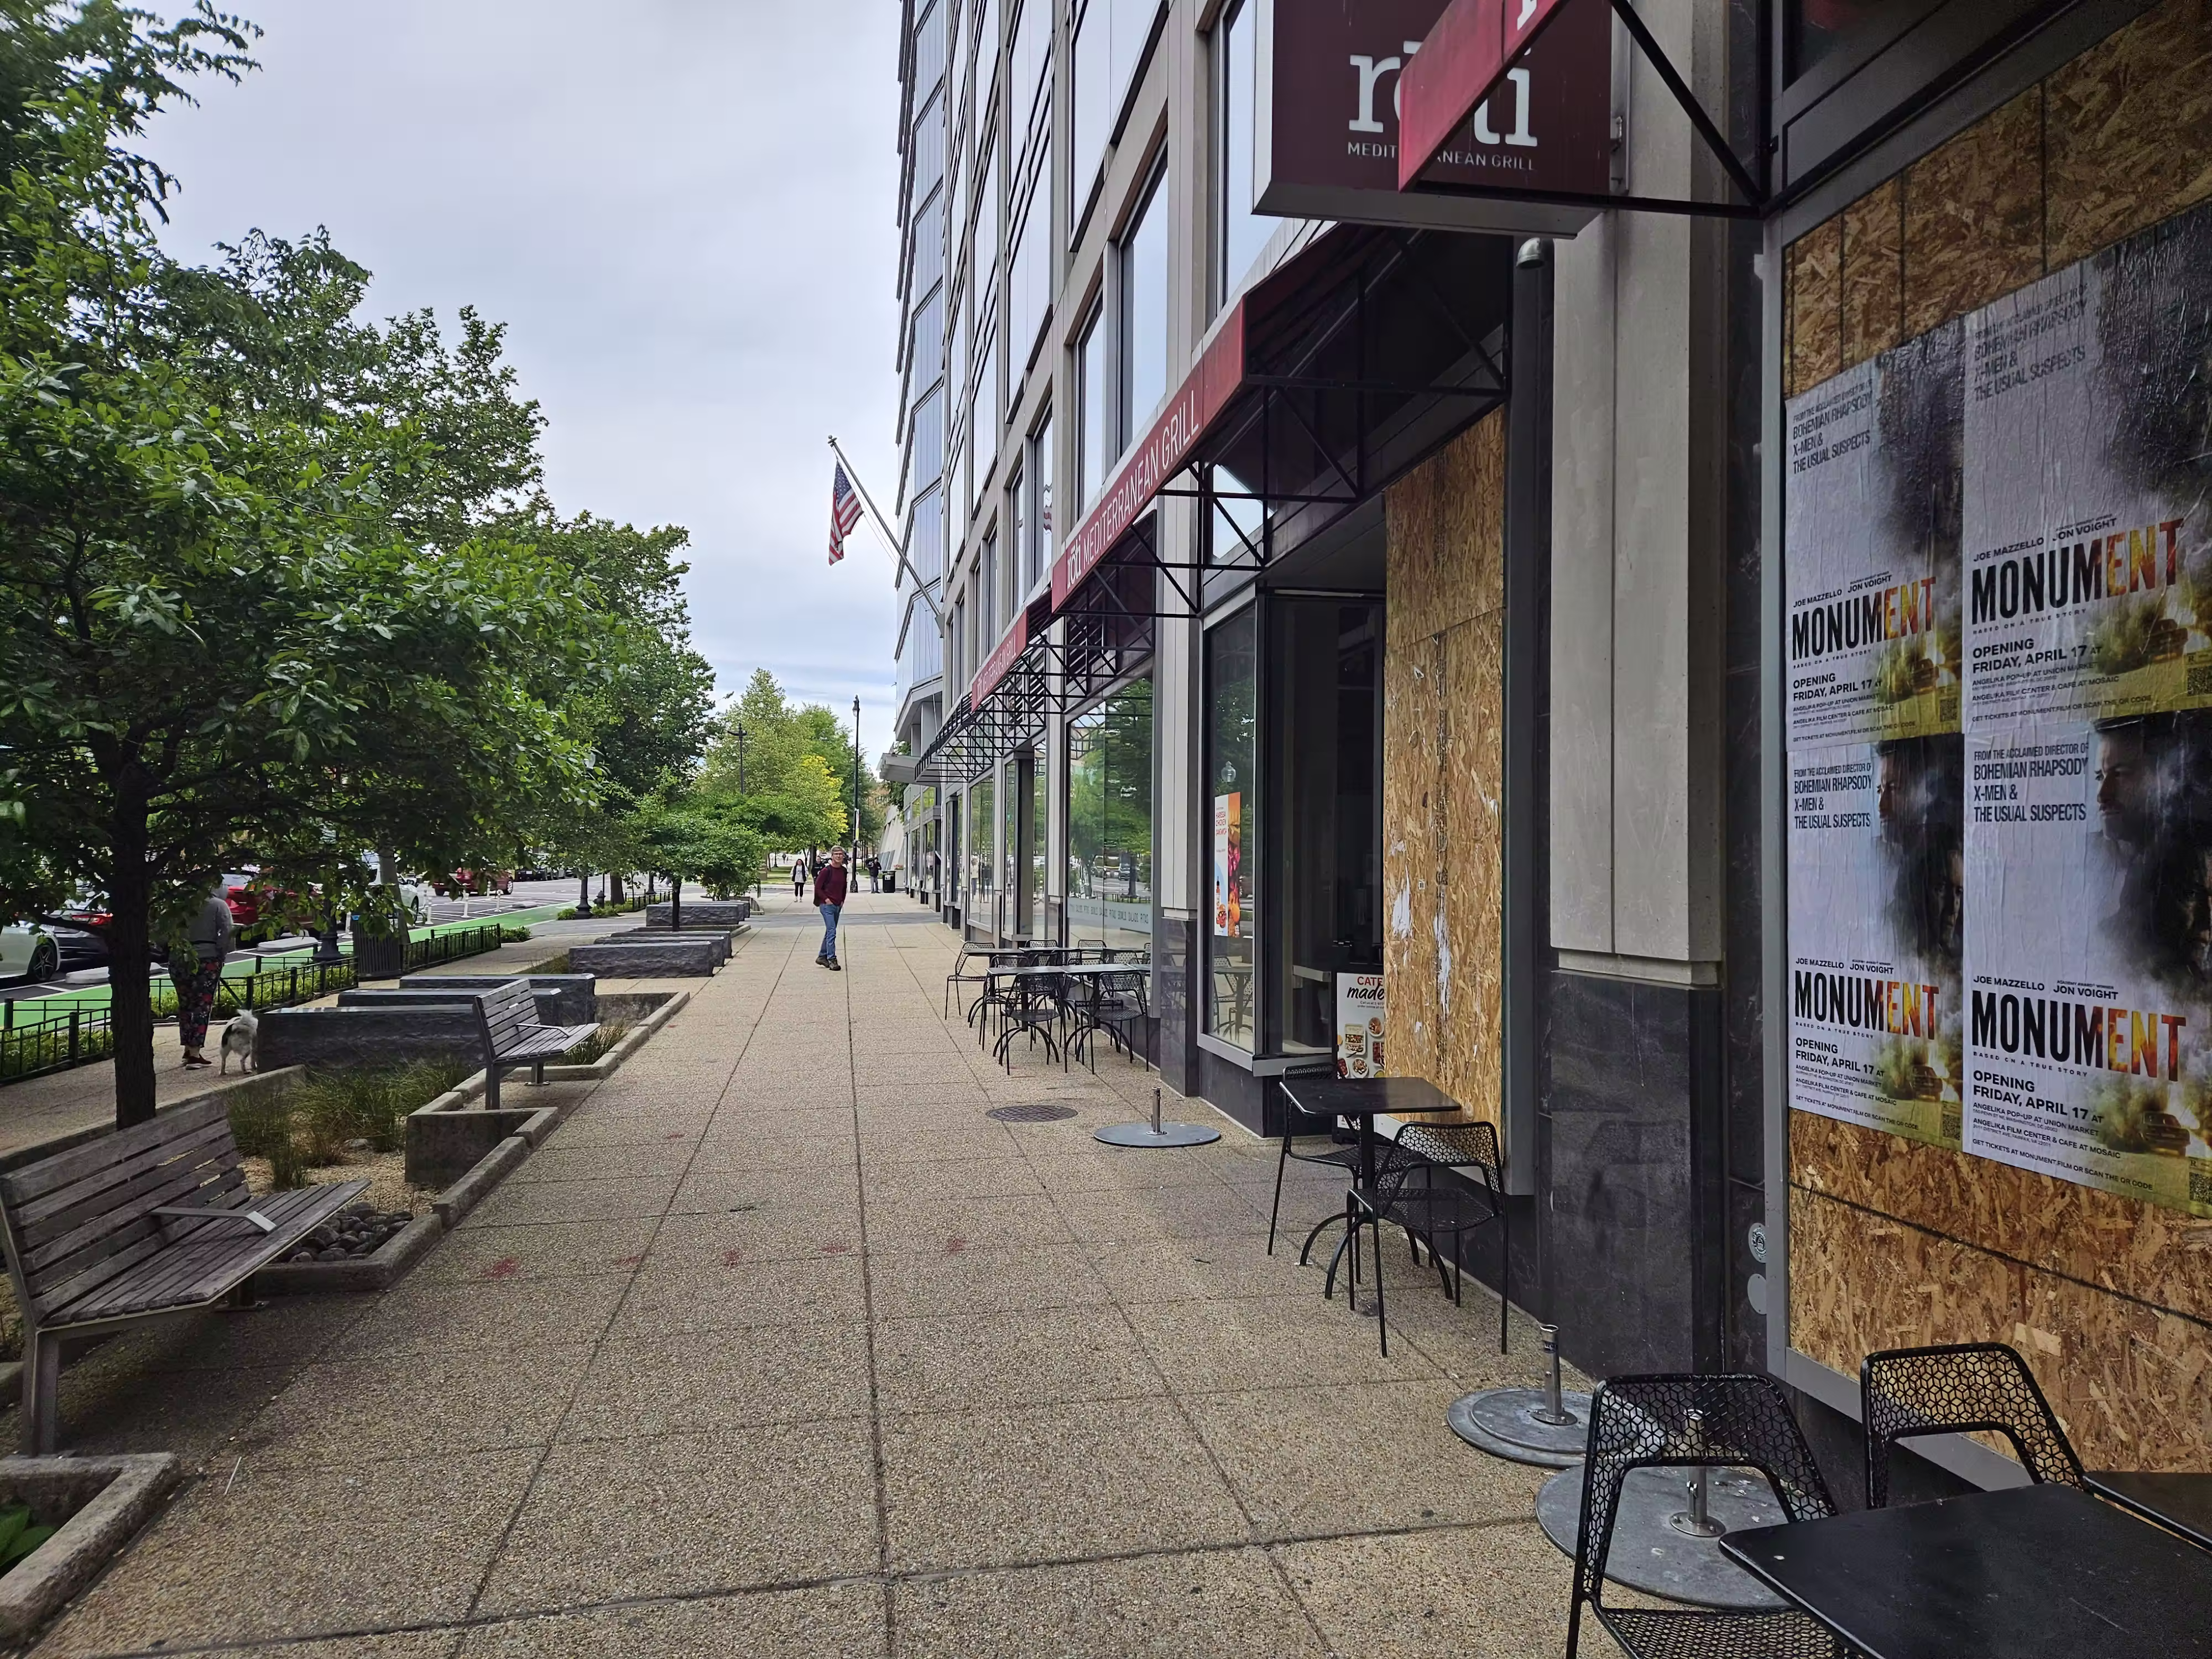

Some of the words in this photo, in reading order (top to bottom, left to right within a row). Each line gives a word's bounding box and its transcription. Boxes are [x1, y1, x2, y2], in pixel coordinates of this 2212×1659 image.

[1349, 40, 1538, 147] ri
[1348, 142, 1486, 166] MEDITNEAN
[1491, 155, 1535, 170] GRILL
[1975, 355, 2006, 383] X-MEN
[2010, 351, 2017, 370] &
[1975, 382, 1992, 402] THE
[1995, 368, 2027, 395] USUAL
[2031, 346, 2085, 382] SUSPECTS
[1793, 410, 1830, 440] BOHEMIAN
[1832, 390, 1872, 423] RHAPSODY
[1793, 435, 1815, 457] X-MEN
[1818, 432, 1823, 447] &
[1793, 456, 1806, 474] THE
[1808, 446, 1830, 468] USUAL
[1832, 430, 1870, 458] SUSPECTS
[1083, 440, 1159, 570] MEDITERRANEAN
[1162, 390, 1198, 470] GRILL
[2077, 518, 2117, 536] VOIGHT
[1974, 550, 1991, 562] JOE
[1994, 538, 2044, 557] MAZZELLO
[1972, 518, 2184, 625] MONUMENT
[1848, 582, 1863, 593] JON
[1864, 575, 1892, 588] VOIGHT
[1793, 598, 1806, 608] JOE
[1808, 589, 1842, 604] MAZZELLO
[1793, 576, 1936, 660] MONUMENT
[1973, 638, 2034, 659] OPENING
[1973, 656, 2021, 674] FRIDAY,
[2026, 648, 2067, 666] APRIL
[2072, 645, 2087, 660] 17
[2090, 646, 2101, 655] AT
[1793, 673, 1835, 689] OPENING
[1793, 687, 1827, 701] FRIDAY,
[1830, 681, 1858, 695] APRIL
[1861, 679, 1872, 690] 17
[1974, 750, 1991, 760] FROM
[1993, 749, 2004, 759] THE
[2006, 747, 2043, 758] ACCLAIMED
[2045, 744, 2078, 755] DIRECTOR
[2081, 743, 2089, 753] OF
[1794, 769, 1806, 777] FROM
[1817, 765, 1841, 775] ACCLAIMED
[1843, 764, 1865, 773] DIRECTOR
[1974, 761, 2027, 780] BOHEMIAN
[2030, 758, 2089, 777] RHAPSODY
[1794, 778, 1830, 794] BOHEMIAN
[1833, 775, 1872, 791] RHAPSODY
[1974, 784, 2006, 801] X-MEN
[2010, 784, 2017, 800] &
[1795, 797, 1817, 811] X-MEN
[1819, 797, 1824, 810] &
[1974, 806, 1992, 822] THE
[1995, 805, 2027, 822] USUAL
[2031, 804, 2086, 821] SUSPECTS
[1794, 816, 1807, 829] THE
[1809, 815, 1832, 828] USUAL
[1833, 813, 1870, 828] SUSPECTS
[1809, 959, 1844, 968] MAZZELLO
[1866, 965, 1893, 974] VOIGHT
[1347, 983, 1384, 1000] made
[1974, 975, 1992, 985] JOE
[1994, 978, 2044, 991] MAZZELLO
[2054, 985, 2075, 995] JON
[2078, 988, 2118, 1000] VOIGHT
[1795, 970, 1939, 1040] MONUMENT
[1796, 1038, 1838, 1053] OPENING
[1972, 990, 2186, 1082] MONUMENT
[1796, 1050, 1829, 1065] FRIDAY,
[1832, 1057, 1860, 1072] APRIL
[1864, 1062, 1874, 1075] 17
[1974, 1052, 1999, 1061] BASED
[2031, 1062, 2052, 1071] TRUE
[2058, 1067, 2088, 1077] STORY
[1796, 1065, 1817, 1073] ANGELIKA
[1860, 1078, 1881, 1087] MARKET
[1974, 1071, 2034, 1092] OPENING
[1796, 1078, 1818, 1087] ANGELIKA
[1830, 1086, 1849, 1094] CENTER
[1876, 1096, 1896, 1105] MOSAIC
[1974, 1085, 2022, 1106] FRIDAY,
[2026, 1095, 2067, 1115] APRIL
[2072, 1105, 2088, 1120] 17
[2091, 1115, 2104, 1124] AT
[1974, 1102, 2005, 1115] ANGELIKA
[2007, 1110, 2032, 1121] POP-UP
[2034, 1115, 2042, 1124] AT
[2044, 1118, 2067, 1129] UNION
[2068, 1123, 2099, 1136] MARKET
[1974, 1118, 2005, 1131] ANGELIKA
[2007, 1125, 2022, 1135] FILM
[2024, 1130, 2051, 1142] CENTER
[2059, 1138, 2077, 1148] CAFE
[2079, 1142, 2088, 1151] AT
[2090, 1145, 2120, 1159] MOSAIC
[1973, 1139, 1983, 1147] GET
[1985, 1142, 2008, 1153] TICKETS
[2085, 1167, 2103, 1177] SCAN
[2105, 1172, 2119, 1181] THE
[2132, 1180, 2152, 1190] CODE
